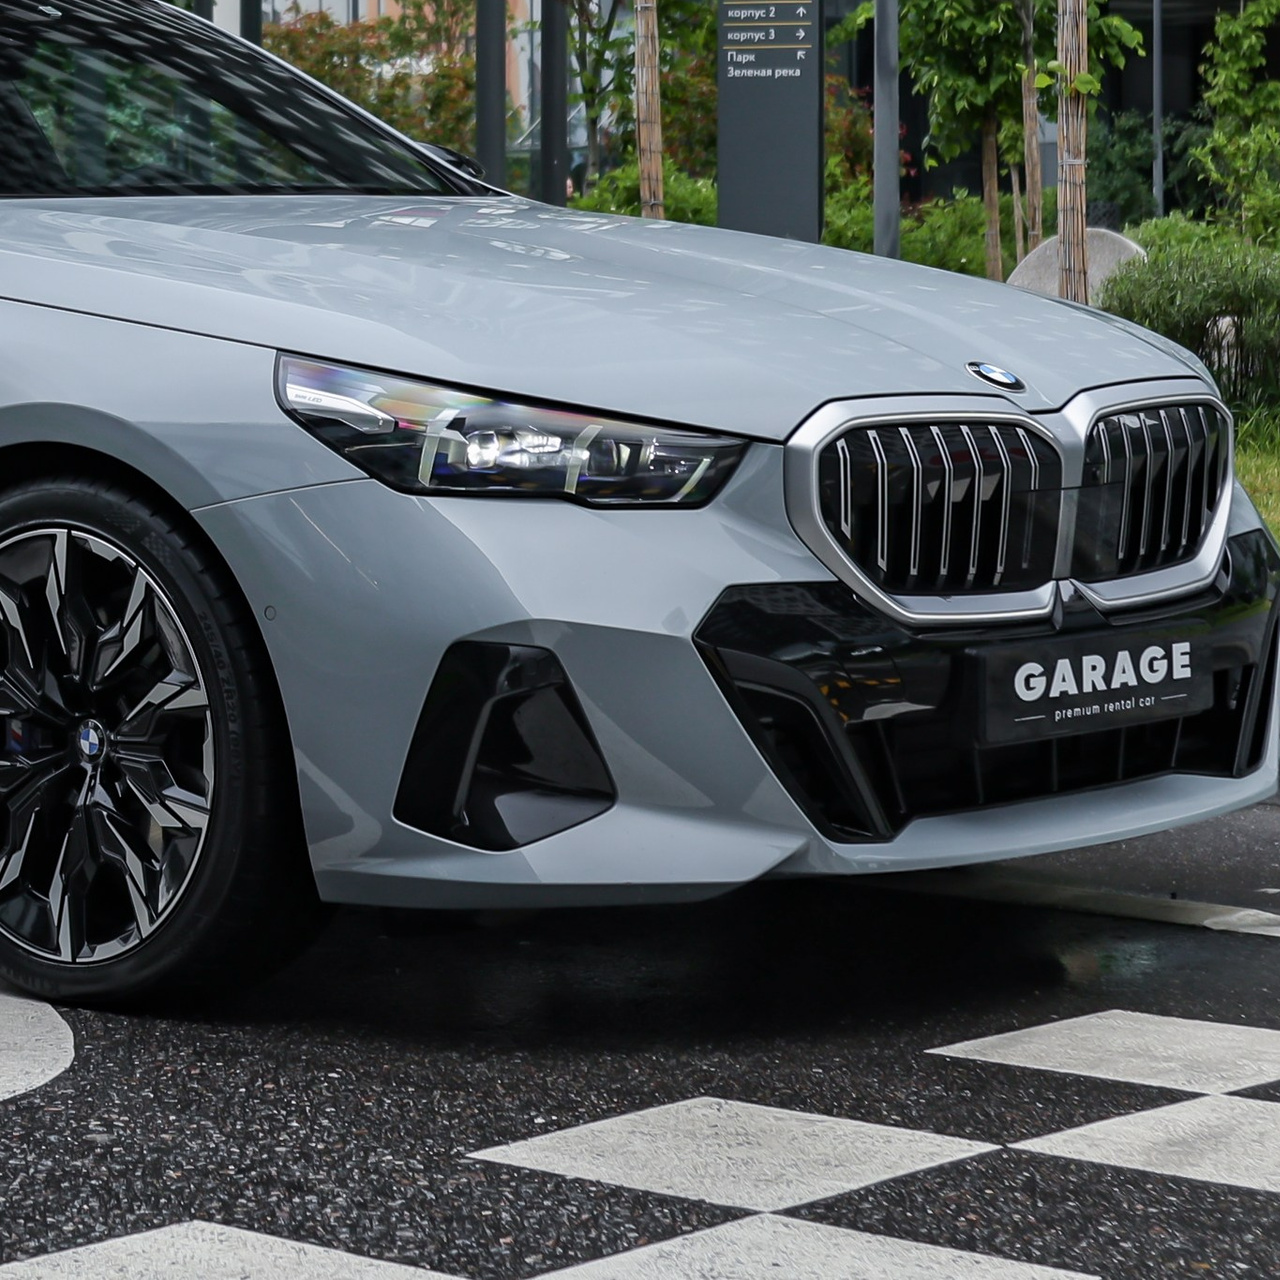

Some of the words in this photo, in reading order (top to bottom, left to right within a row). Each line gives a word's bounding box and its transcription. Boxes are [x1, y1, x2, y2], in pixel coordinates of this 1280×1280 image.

[727, 9, 766, 20] корпус
[769, 6, 776, 17] 2
[727, 32, 766, 42] корпус
[768, 28, 775, 40] 3
[727, 51, 756, 64] Парк
[727, 66, 773, 77] Зеленая
[774, 68, 801, 79] река
[1014, 641, 1192, 702] GARAGE
[1055, 704, 1101, 722] premium
[1104, 697, 1135, 712] rental
[1139, 696, 1156, 707] car
